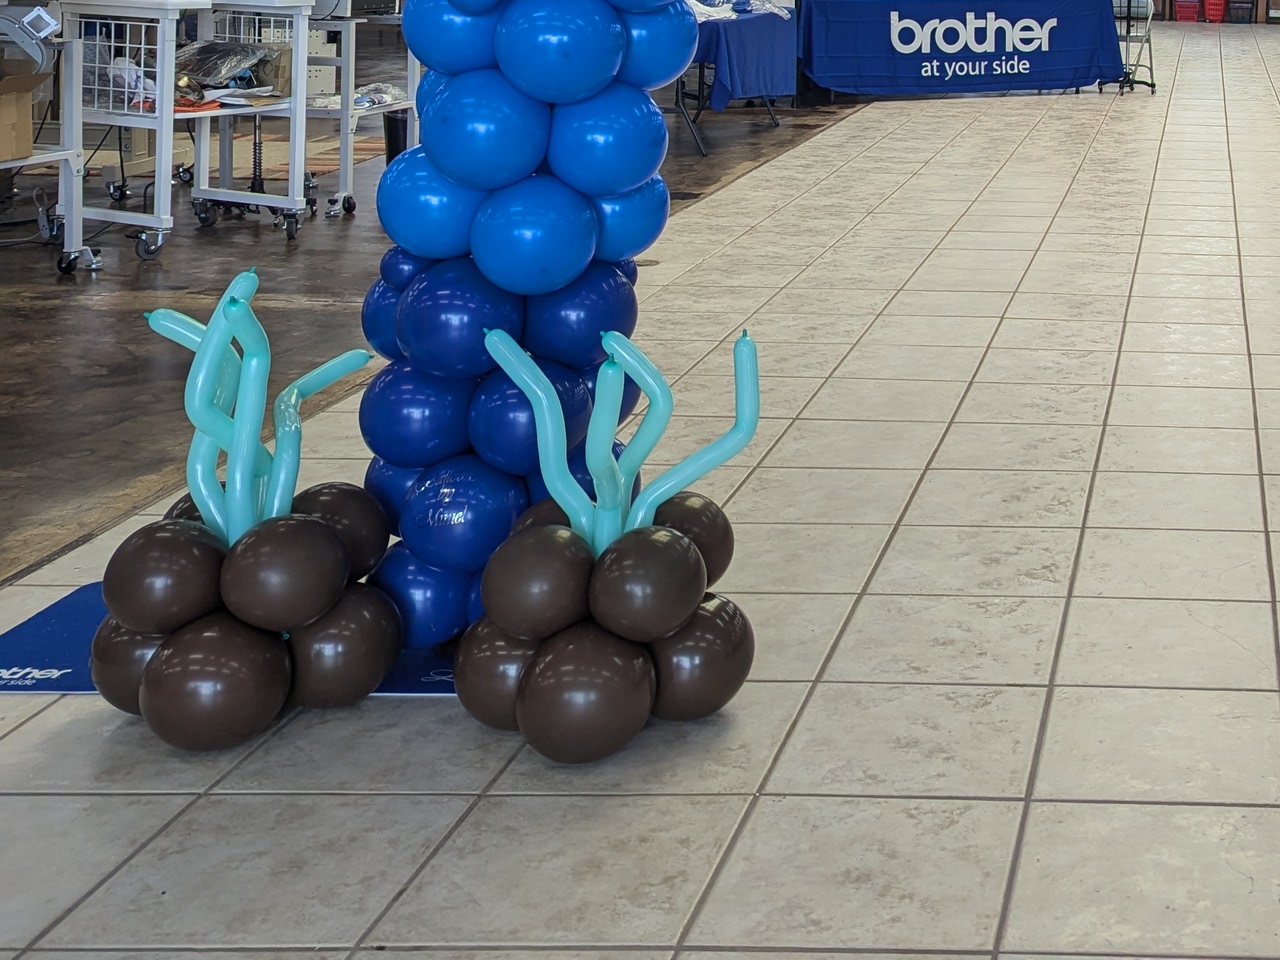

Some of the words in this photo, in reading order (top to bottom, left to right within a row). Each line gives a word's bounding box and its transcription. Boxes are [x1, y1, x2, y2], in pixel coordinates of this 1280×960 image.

[890, 11, 1057, 54] brother
[921, 59, 940, 77] at
[944, 60, 988, 81] your
[992, 55, 1030, 75] side
